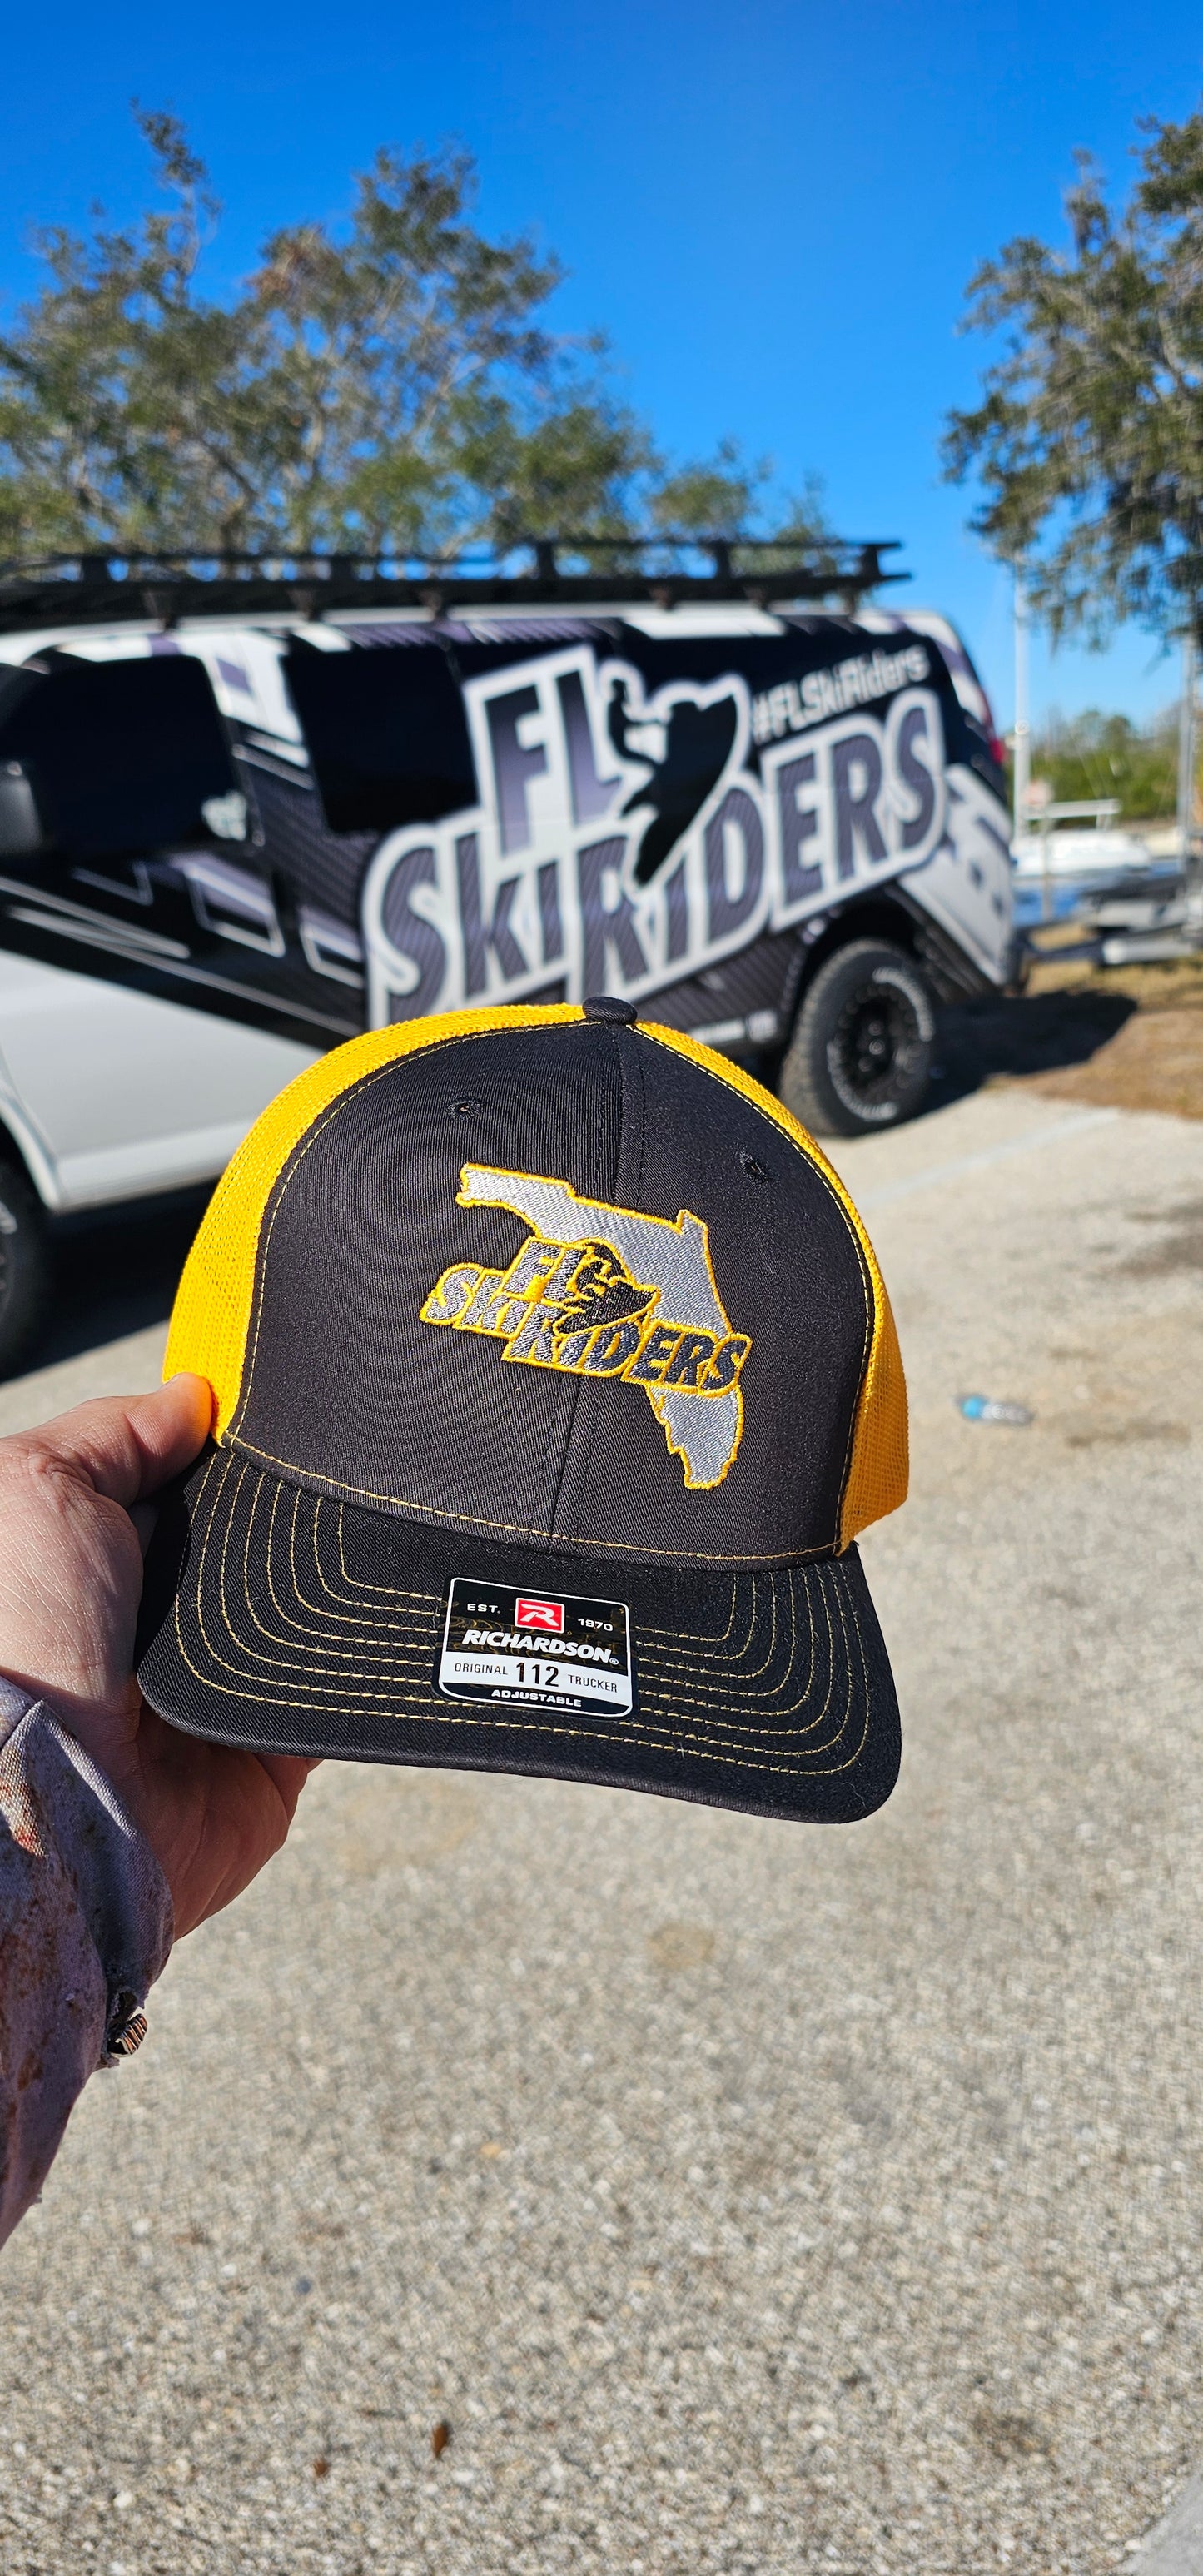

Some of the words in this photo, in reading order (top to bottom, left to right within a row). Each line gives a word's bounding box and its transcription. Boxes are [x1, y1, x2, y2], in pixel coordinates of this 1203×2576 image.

[752, 644, 931, 745] #FLSkiRiders
[478, 663, 624, 855] FL
[466, 1603, 501, 1614] EST.
[578, 1618, 614, 1632] 1970
[454, 1663, 508, 1675] ORIGINAL
[516, 1663, 559, 1688] 112
[568, 1674, 618, 1693] TRUCKER
[491, 1688, 582, 1708] ADJUSTABLE
